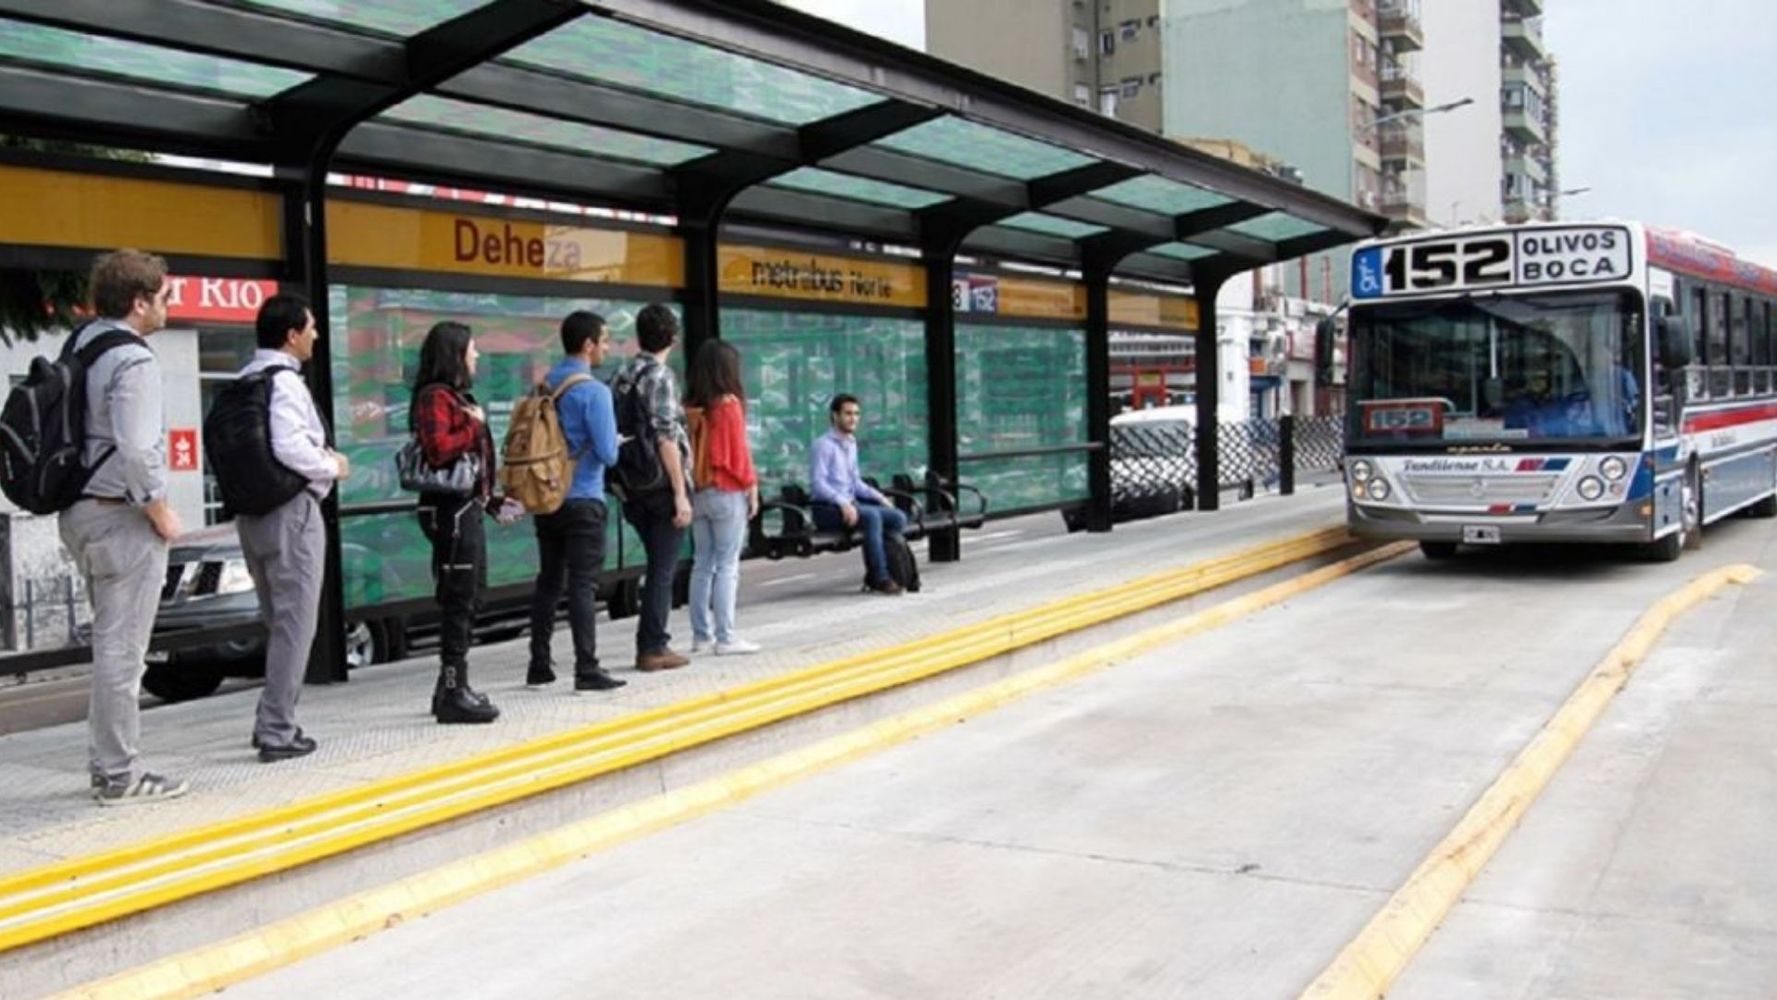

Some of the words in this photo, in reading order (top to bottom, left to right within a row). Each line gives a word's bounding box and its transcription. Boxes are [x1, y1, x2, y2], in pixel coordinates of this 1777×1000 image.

[454, 218, 581, 268] Deheza
[1522, 230, 1616, 256] OLIVOS
[1385, 239, 1511, 291] 152
[1522, 256, 1615, 281] BOCA
[1372, 409, 1431, 429] 152
